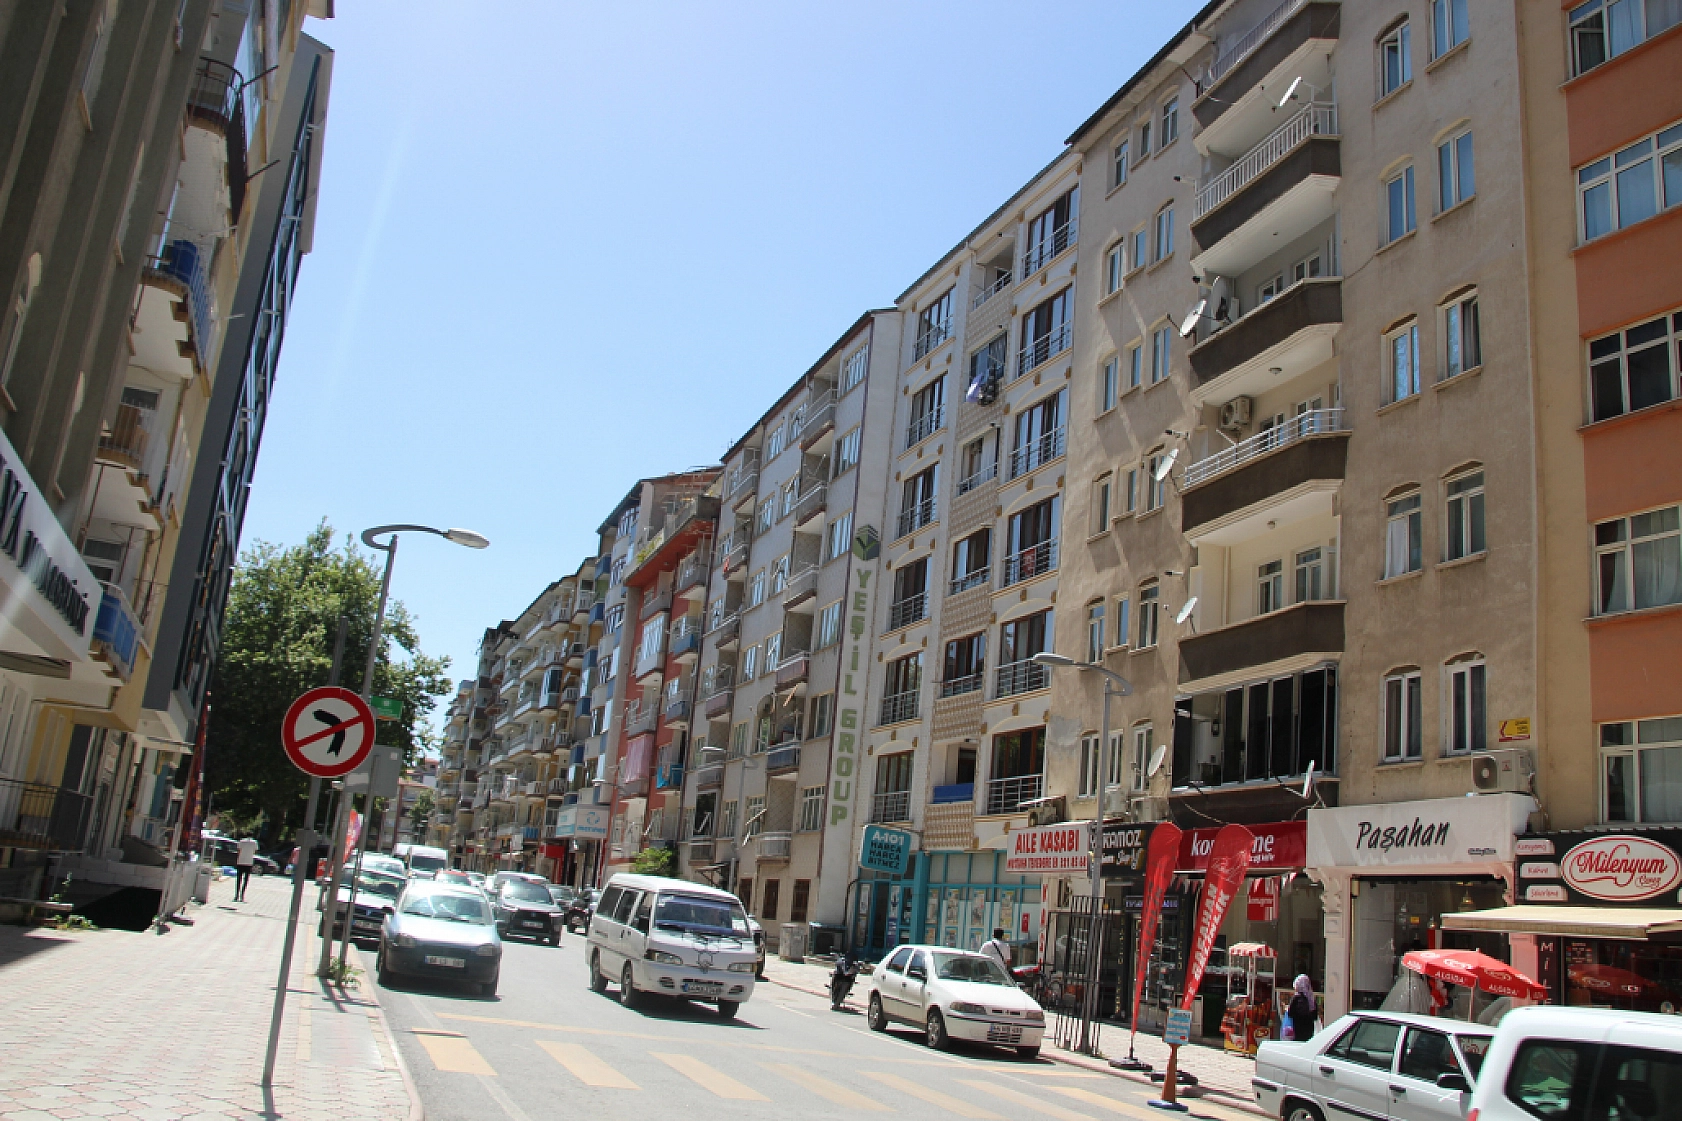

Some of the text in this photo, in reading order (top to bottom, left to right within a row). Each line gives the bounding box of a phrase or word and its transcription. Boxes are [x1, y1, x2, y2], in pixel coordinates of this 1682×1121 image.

[830, 569, 872, 826] YEŞİL GROUP
[872, 830, 905, 846] A-101
[1040, 829, 1079, 853] KASABI
[1356, 816, 1450, 853] Paşahan
[1571, 844, 1667, 886] Milenyum
[1435, 970, 1464, 984] ALGIDA
